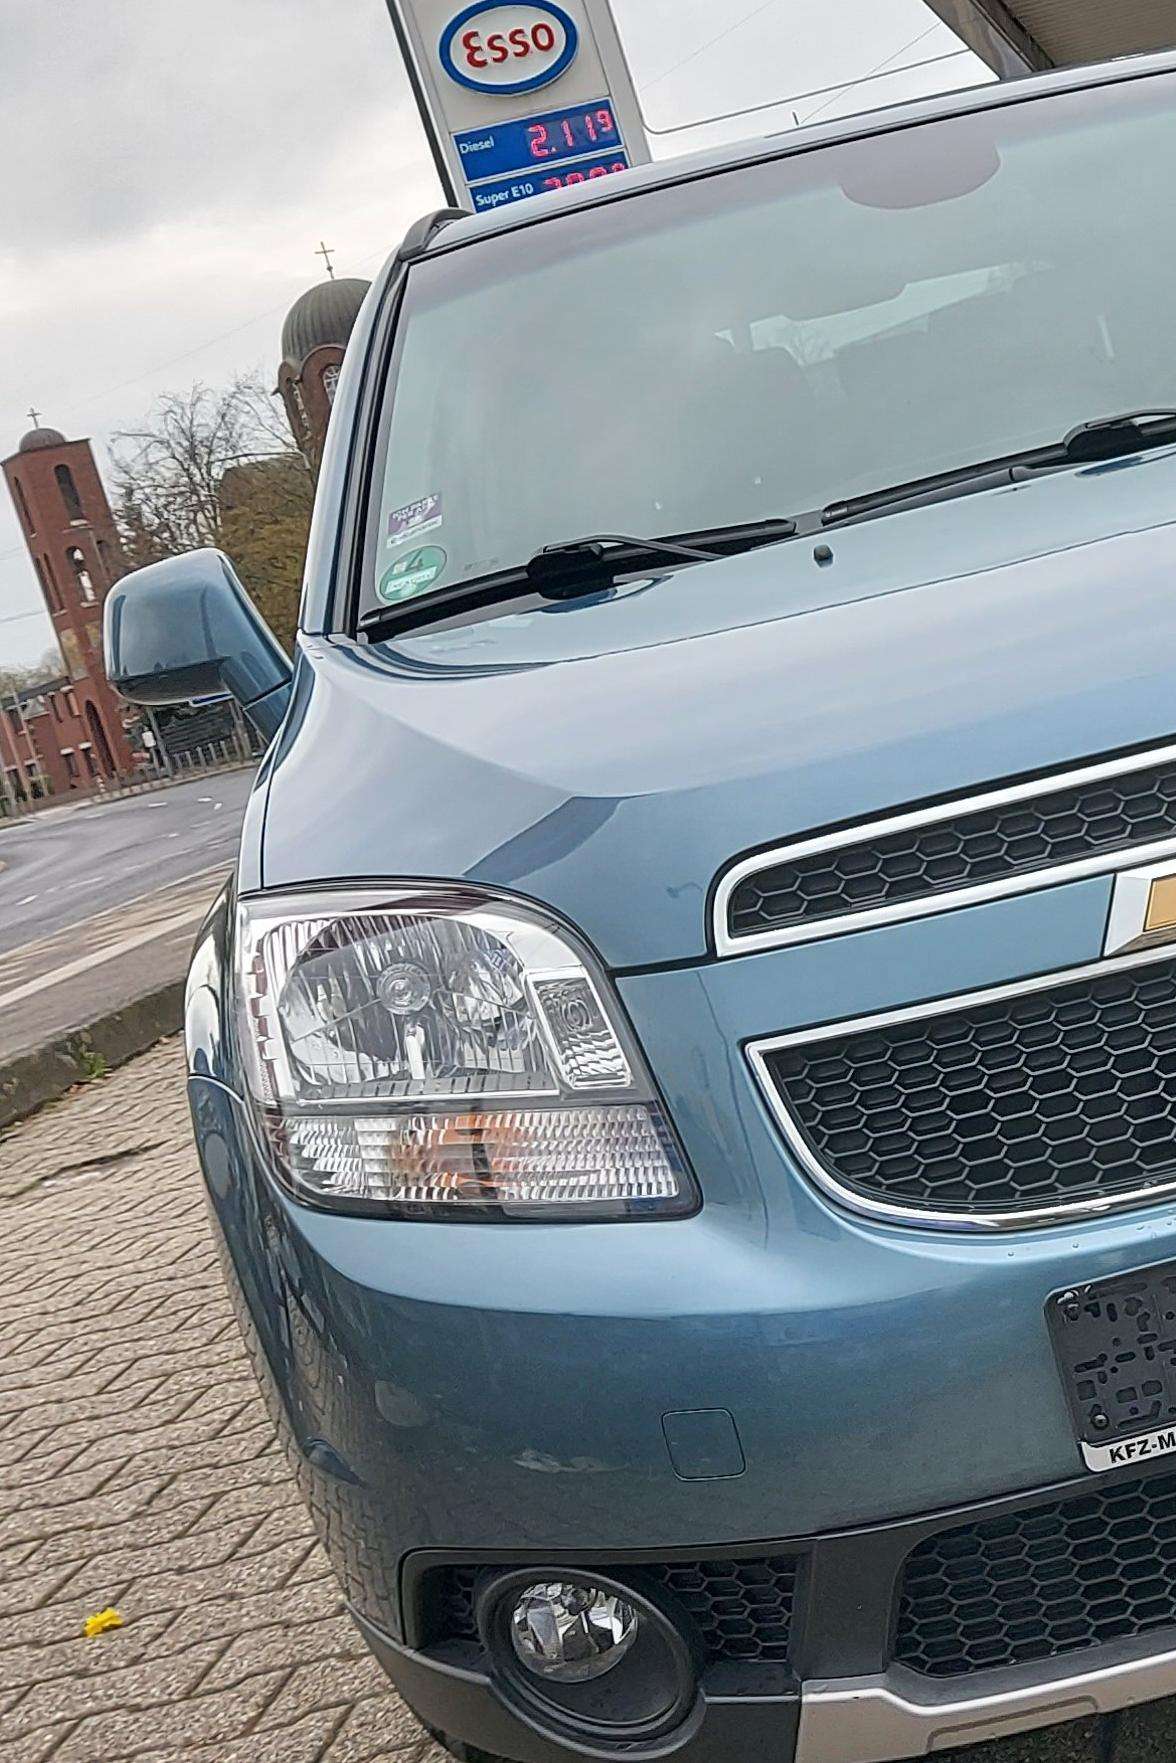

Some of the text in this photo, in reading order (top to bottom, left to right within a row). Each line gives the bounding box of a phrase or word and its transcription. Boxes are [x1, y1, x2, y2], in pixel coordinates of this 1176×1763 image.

[460, 110, 613, 158] Diesel 2.119
[475, 183, 534, 208] Super E10
